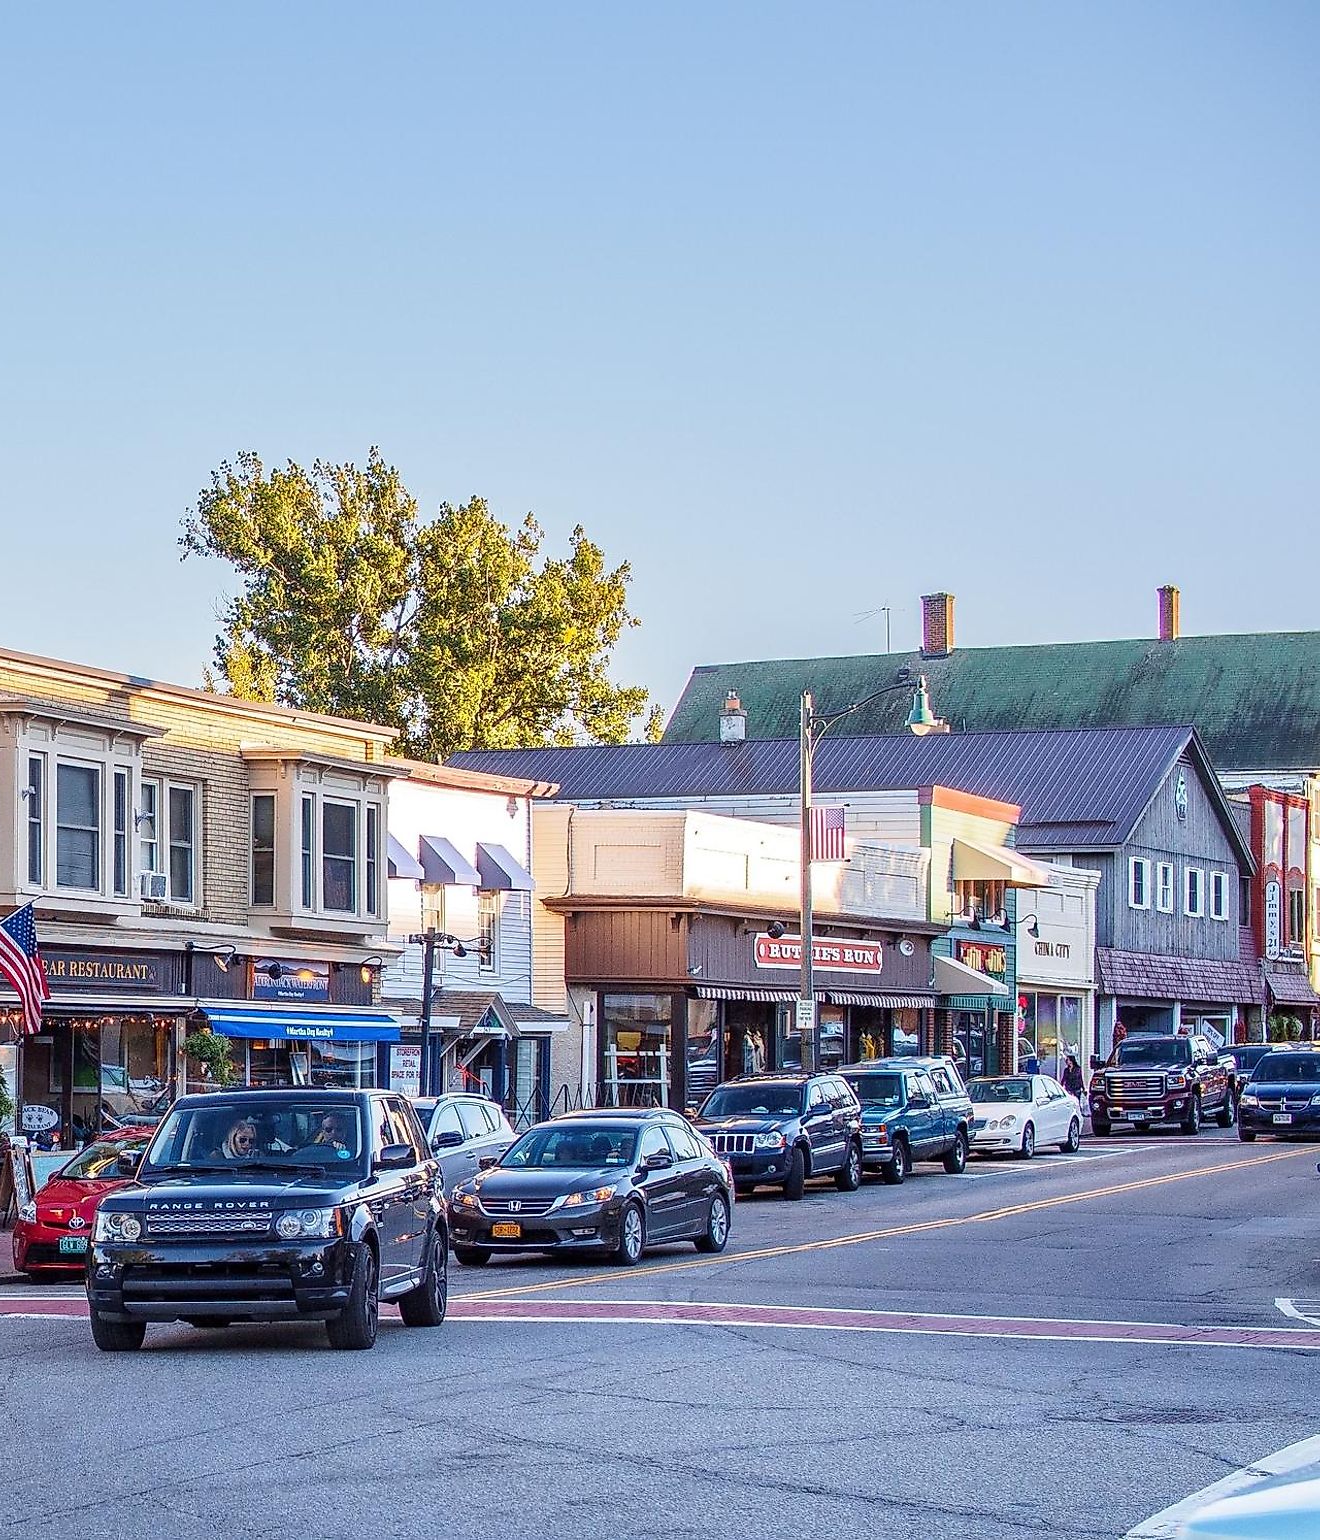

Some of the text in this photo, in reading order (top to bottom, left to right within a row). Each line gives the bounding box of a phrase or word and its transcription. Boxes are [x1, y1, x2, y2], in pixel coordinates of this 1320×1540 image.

[1268, 938, 1277, 947] 21
[768, 943, 840, 962] RUTIE'S
[1034, 941, 1071, 959] CHINA CITY
[42, 959, 148, 980] EAR RESTAURANT
[402, 1059, 416, 1067] RETAIL
[391, 1070, 405, 1078] SPACE
[406, 1070, 415, 1078] FOR
